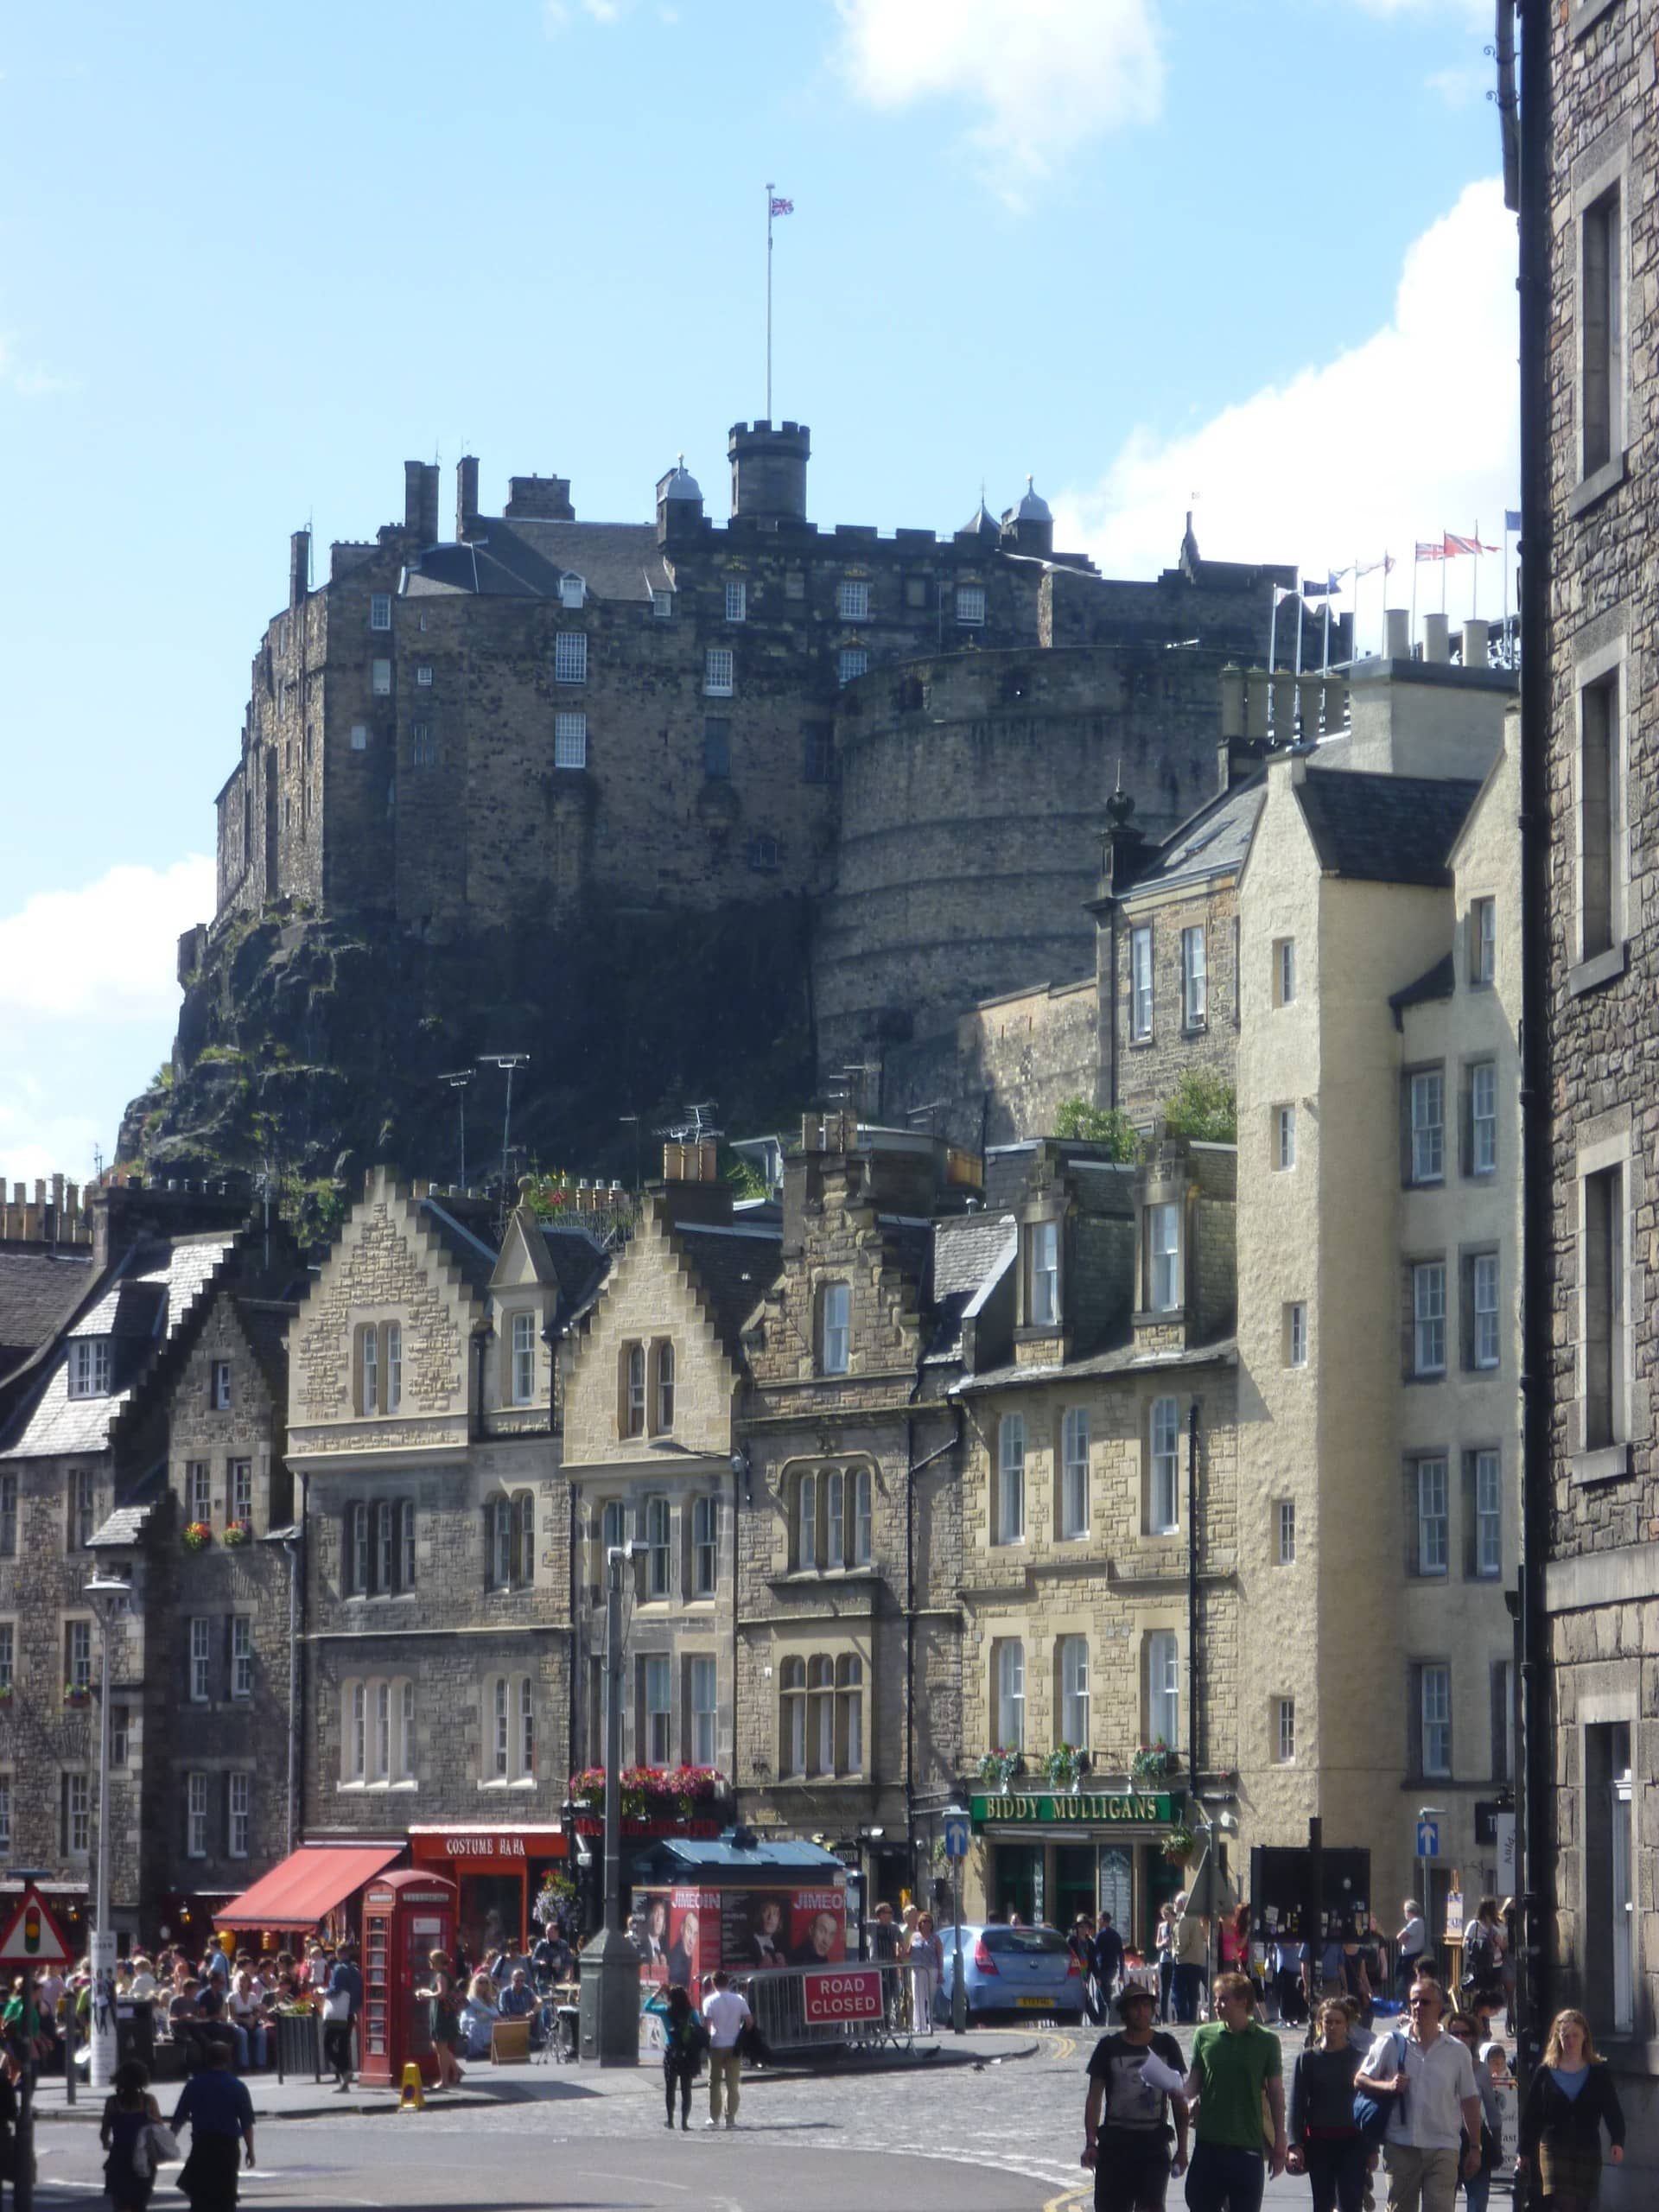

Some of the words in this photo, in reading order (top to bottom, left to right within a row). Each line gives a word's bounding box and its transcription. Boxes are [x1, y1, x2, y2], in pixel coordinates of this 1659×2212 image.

[987, 1797, 1038, 1818] BIDDY
[1052, 1797, 1157, 1819] MULLIGANS
[446, 1838, 493, 1855] COSTUME
[820, 1978, 865, 1994] ROAD
[811, 1996, 876, 2014] CLOSED
